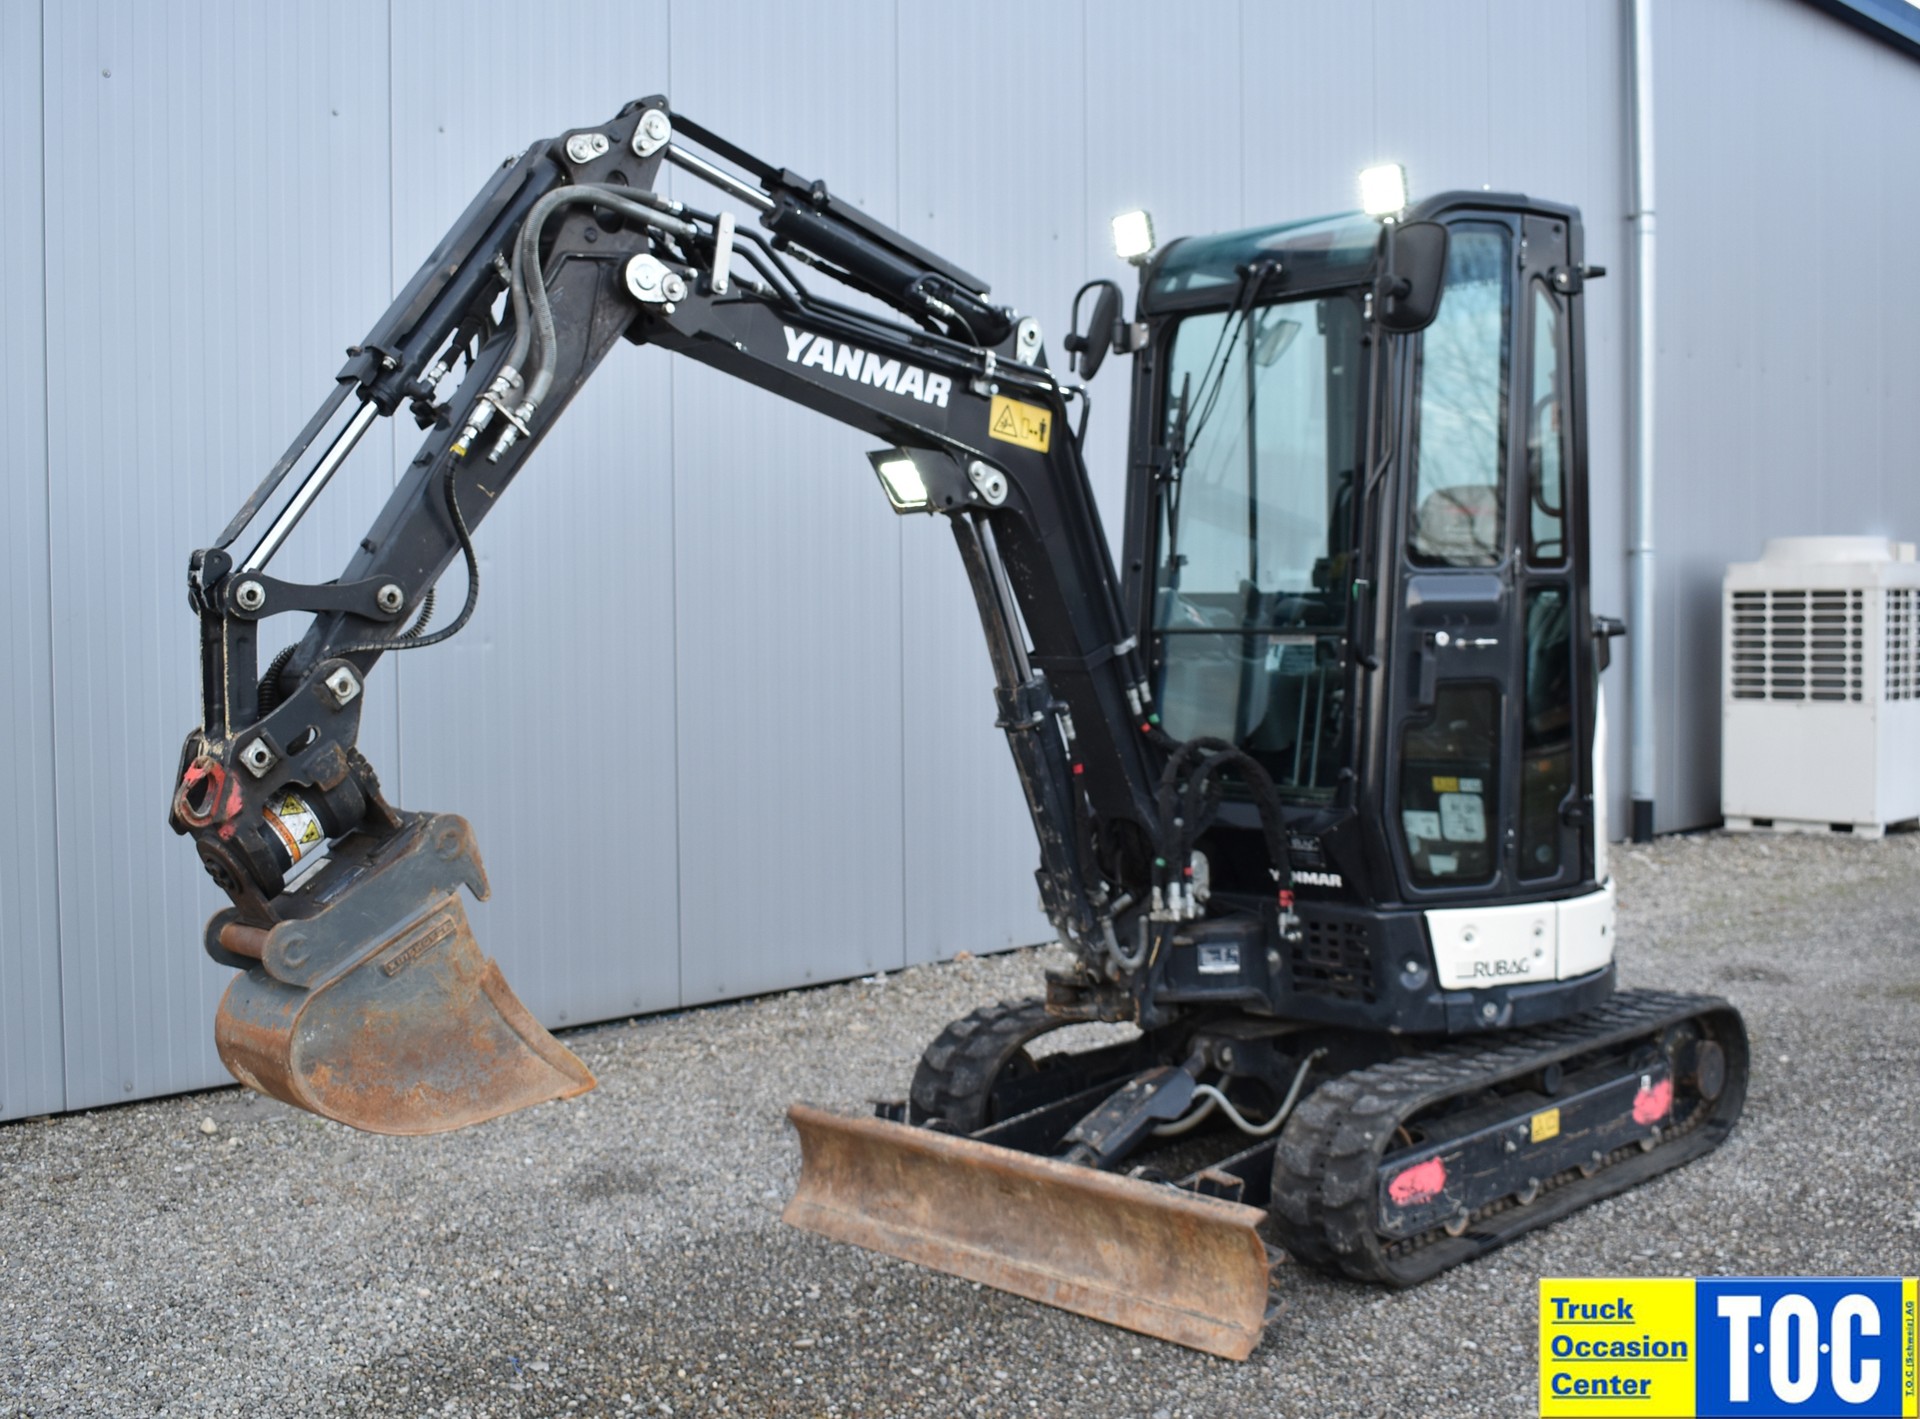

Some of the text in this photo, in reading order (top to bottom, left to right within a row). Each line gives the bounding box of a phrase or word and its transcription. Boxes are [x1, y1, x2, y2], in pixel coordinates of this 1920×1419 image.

[782, 325, 953, 409] YANMAR
[1268, 867, 1343, 889] YNMAR
[1473, 957, 1531, 978] RUBAG
